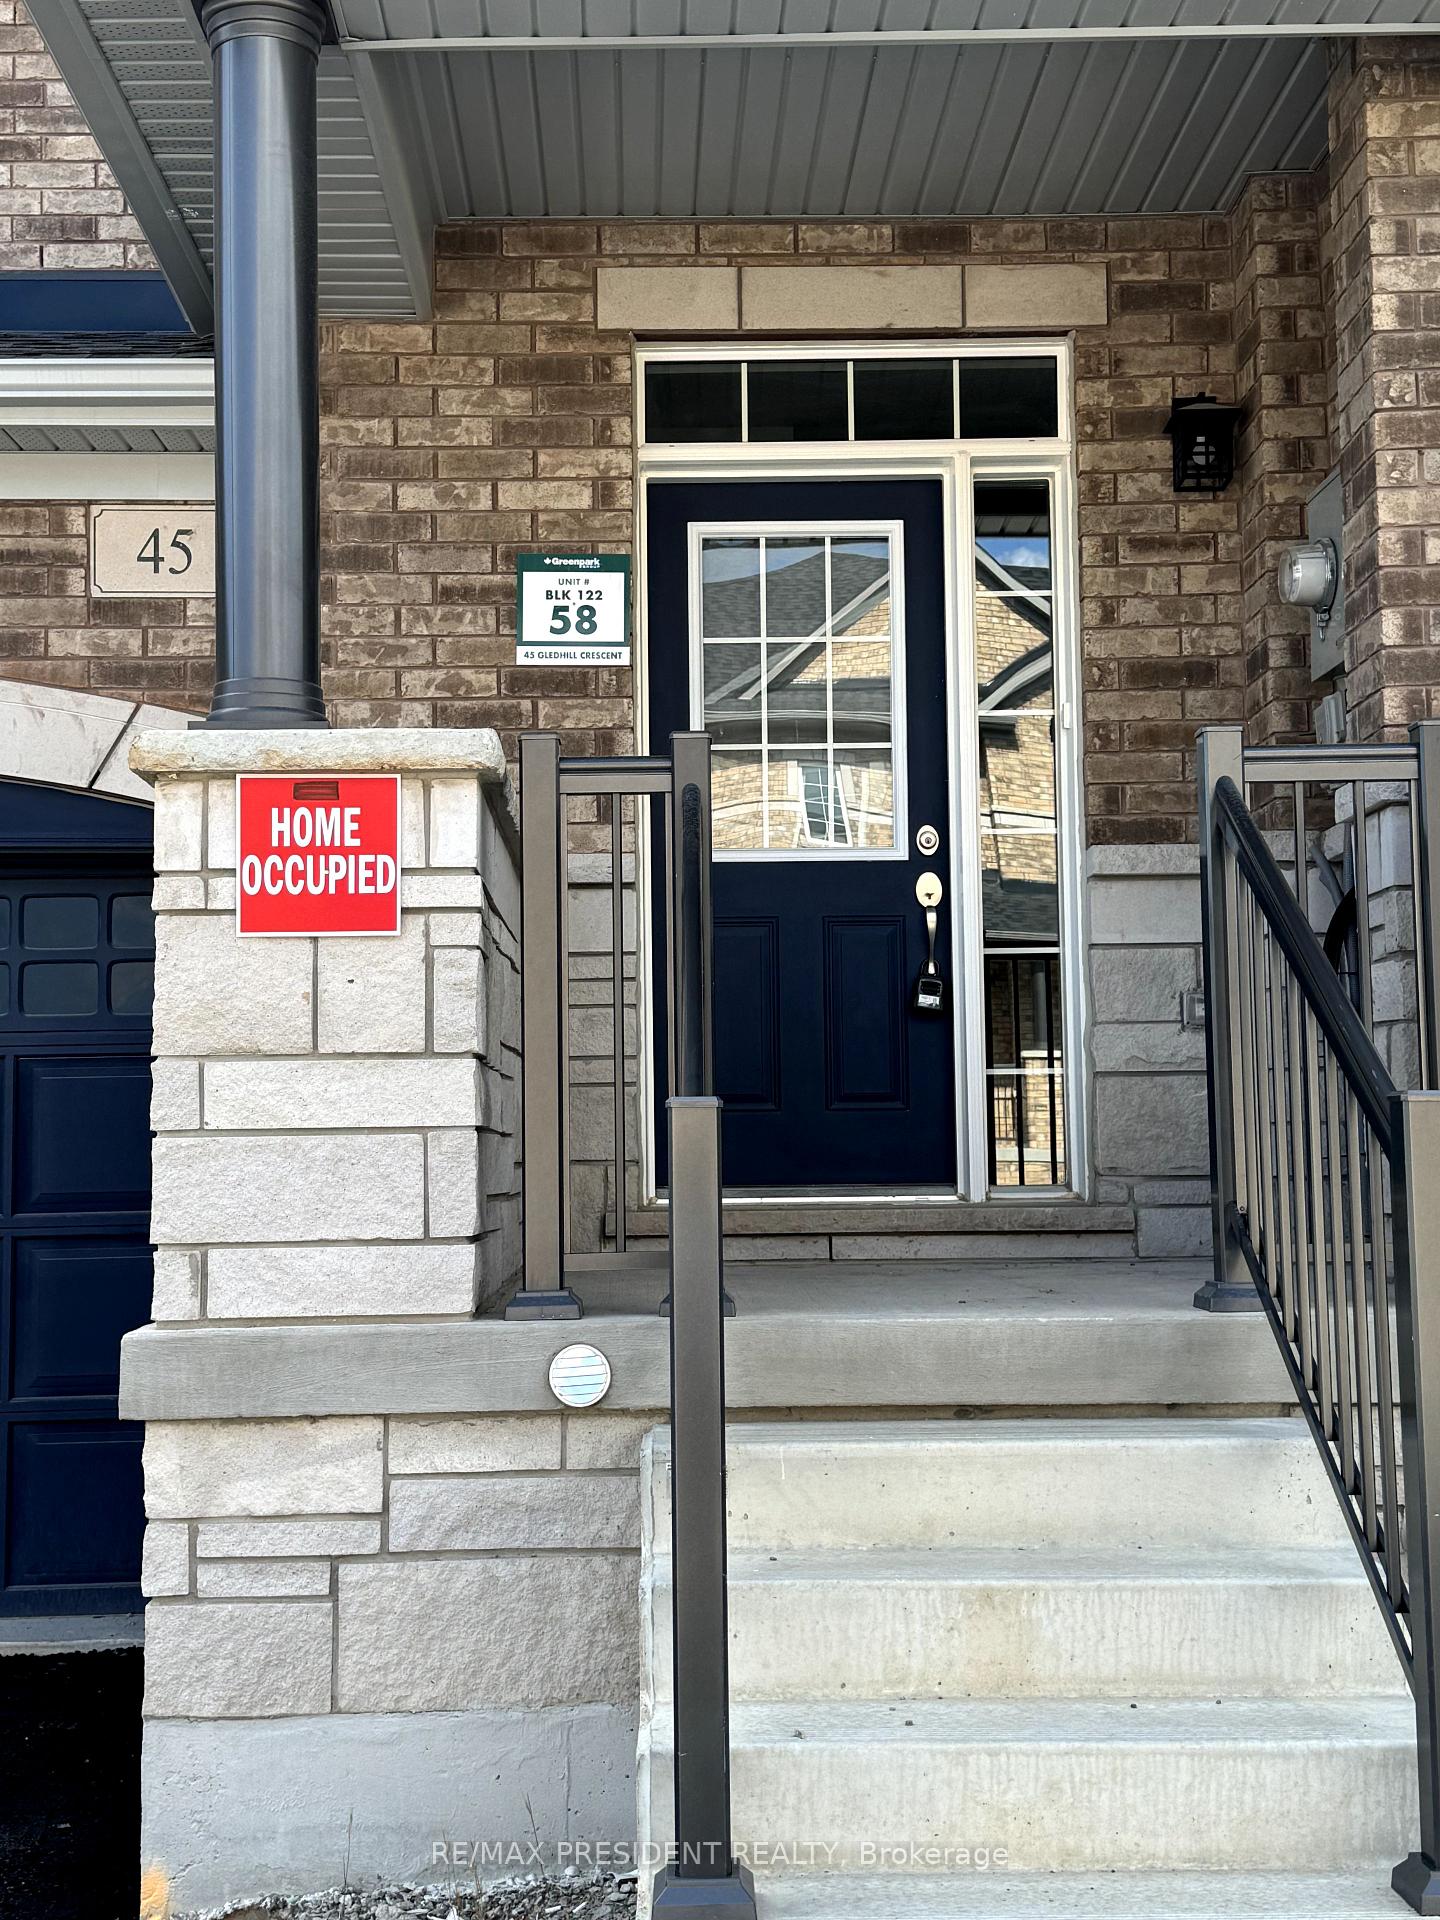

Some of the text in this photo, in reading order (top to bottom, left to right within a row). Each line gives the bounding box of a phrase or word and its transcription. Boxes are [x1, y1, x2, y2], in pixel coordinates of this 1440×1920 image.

[136, 528, 194, 575] 45
[551, 557, 600, 569] Greenpark
[558, 578, 590, 586] UNIT #
[545, 590, 603, 600] BLK 122
[549, 604, 598, 635] 58
[523, 651, 623, 660] 45 GLEDHILL CRESCENT
[271, 806, 361, 848] HOME
[241, 854, 396, 896] OCCUPIED
